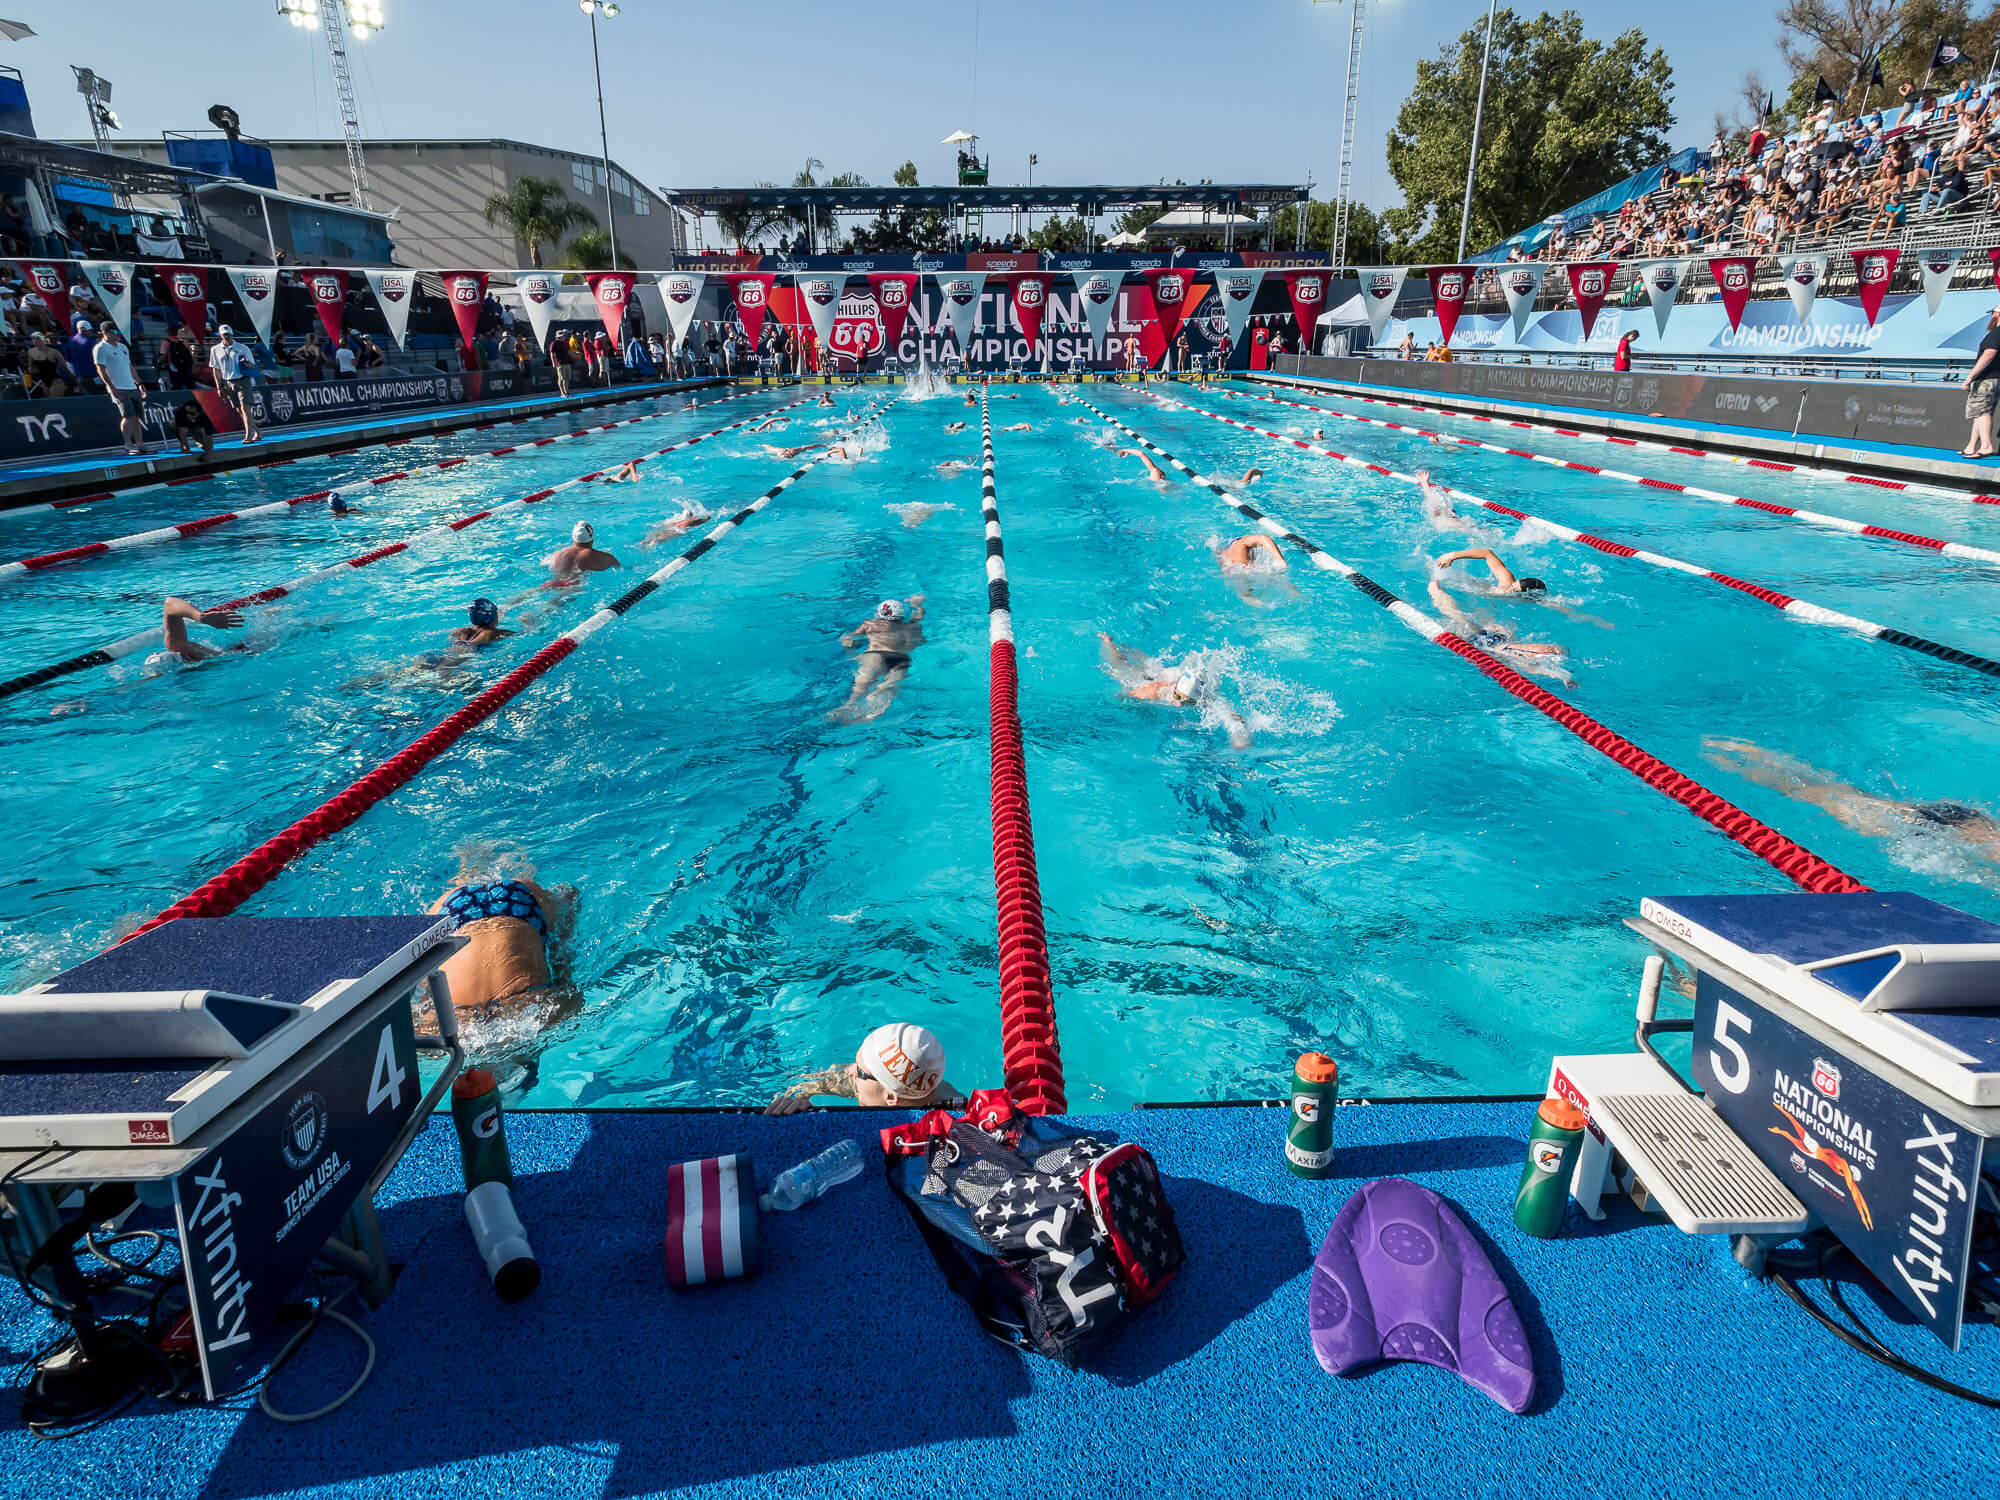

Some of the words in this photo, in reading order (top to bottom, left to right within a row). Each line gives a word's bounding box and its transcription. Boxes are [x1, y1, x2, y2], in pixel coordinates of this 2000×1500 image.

[1252, 191, 1270, 201] VIP
[1272, 190, 1298, 200] DECK
[1931, 252, 1948, 260] USA
[776, 262, 808, 271] speedo
[844, 260, 874, 270] speedo
[913, 260, 944, 270] speedo
[986, 260, 1017, 269] speedo
[1060, 259, 1092, 268] speedo
[1130, 258, 1162, 268] speedo
[1199, 258, 1230, 268] speedo
[102, 272, 120, 280] USA
[1514, 274, 1531, 282] USA
[1865, 268, 1882, 278] 66
[40, 276, 55, 288] 66
[246, 278, 264, 286] USA
[384, 279, 400, 287] USA
[530, 280, 548, 289] USA
[672, 282, 689, 290] USA
[1232, 278, 1248, 286] USA
[1728, 275, 1743, 286] 66
[179, 284, 196, 296] 66
[1162, 286, 1178, 298] 66
[1443, 284, 1458, 295] 66
[1584, 281, 1599, 292] 66
[319, 287, 335, 298] 66
[458, 289, 473, 300] 66
[604, 289, 618, 300] 66
[744, 292, 759, 302] 66
[886, 292, 900, 302] 66
[1022, 292, 1038, 302] 66
[1301, 288, 1317, 298] 66
[838, 304, 875, 316] HILLIPS
[834, 322, 872, 346] 66
[1450, 329, 1504, 345] AMPIONSHIP
[1720, 324, 1883, 350] CHAMPIONSHIP
[1488, 370, 1527, 388] NATIONAL
[1530, 374, 1614, 395] CHAMPIONSHIPS
[295, 386, 354, 408] NATIONAL
[357, 380, 434, 401] CHAMPIONSHIPS
[1715, 394, 1750, 411] arena
[16, 413, 72, 443] TYR
[1656, 912, 1692, 938] OMEGA
[422, 922, 452, 951] OMEGA
[1709, 999, 1752, 1095] 5
[366, 1023, 406, 1116] 4
[878, 1038, 938, 1092] TEXAS
[1816, 1074, 1834, 1092] 66
[1774, 1068, 1878, 1156] NATIONAL
[130, 1130, 168, 1142] OMEGA
[1772, 1091, 1876, 1172] CHAMPIONSHIPS
[1287, 1144, 1328, 1168] MAXIM
[284, 1174, 316, 1218] TEAM
[317, 1151, 340, 1185] USA
[276, 1210, 301, 1242] SUMMER
[301, 1178, 334, 1215] CHAMPIONS
[333, 1160, 351, 1184] SERIES
[1893, 1112, 1967, 1320] xfinity
[188, 1156, 254, 1353] xfinity
[1025, 1204, 1116, 1328] TYR
